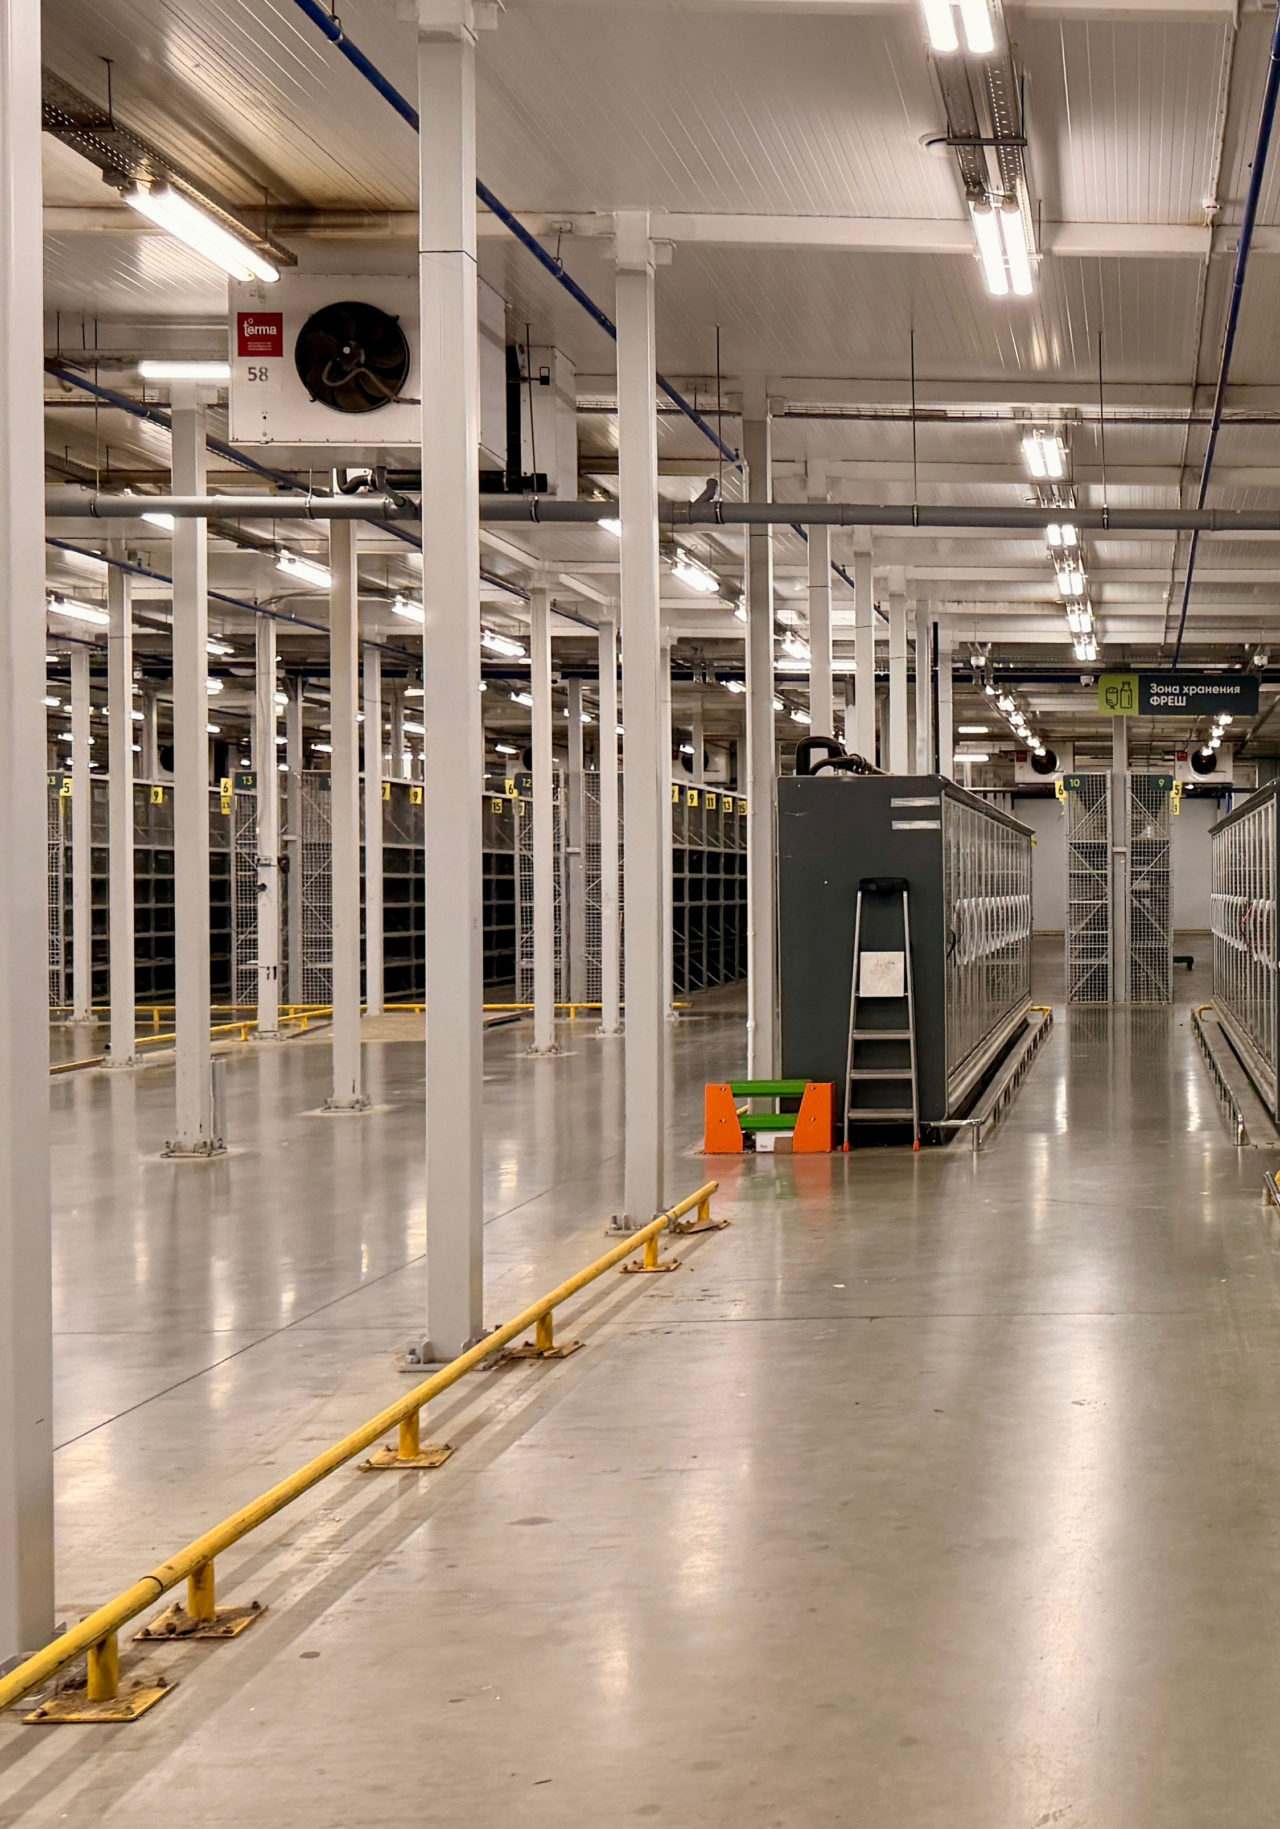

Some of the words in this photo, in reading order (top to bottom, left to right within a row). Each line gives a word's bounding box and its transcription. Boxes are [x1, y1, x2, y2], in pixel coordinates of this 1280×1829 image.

[243, 318, 277, 337] terma
[247, 366, 269, 382] 58
[1149, 683, 1180, 694] Зона
[1182, 685, 1241, 696] хранения
[1149, 695, 1187, 706] ФРЕШ
[242, 776, 253, 785] 13
[522, 778, 532, 787] 12
[1069, 779, 1080, 788] 10
[1158, 779, 1165, 787] 9
[63, 782, 70, 794] 5
[223, 782, 229, 794] 6
[508, 784, 514, 795] 6
[1058, 785, 1064, 795] 6
[1174, 784, 1180, 796] 5
[153, 790, 159, 802] 9
[413, 791, 419, 802] 9
[689, 793, 695, 804] 9
[492, 801, 501, 811] 15
[707, 797, 714, 807] 11
